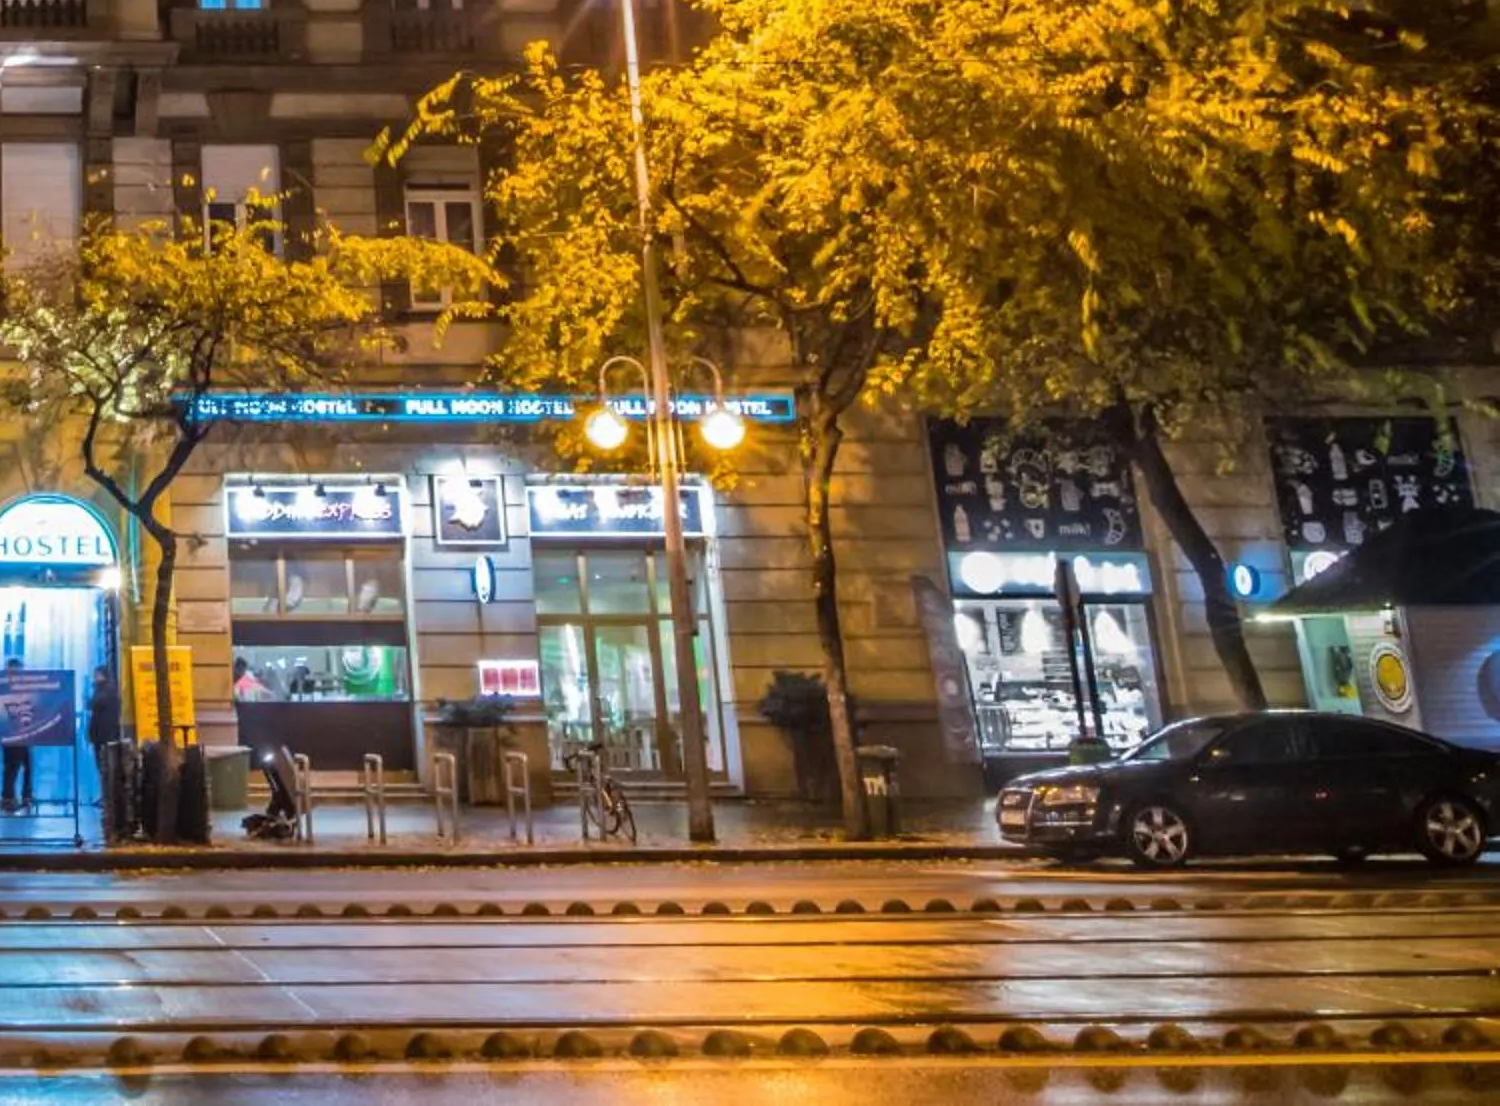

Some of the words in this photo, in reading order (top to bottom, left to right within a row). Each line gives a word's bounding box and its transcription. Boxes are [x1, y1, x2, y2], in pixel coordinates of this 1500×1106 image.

[405, 399, 448, 415] FULL
[451, 399, 503, 415] MOON
[706, 400, 772, 415] HSTEL
